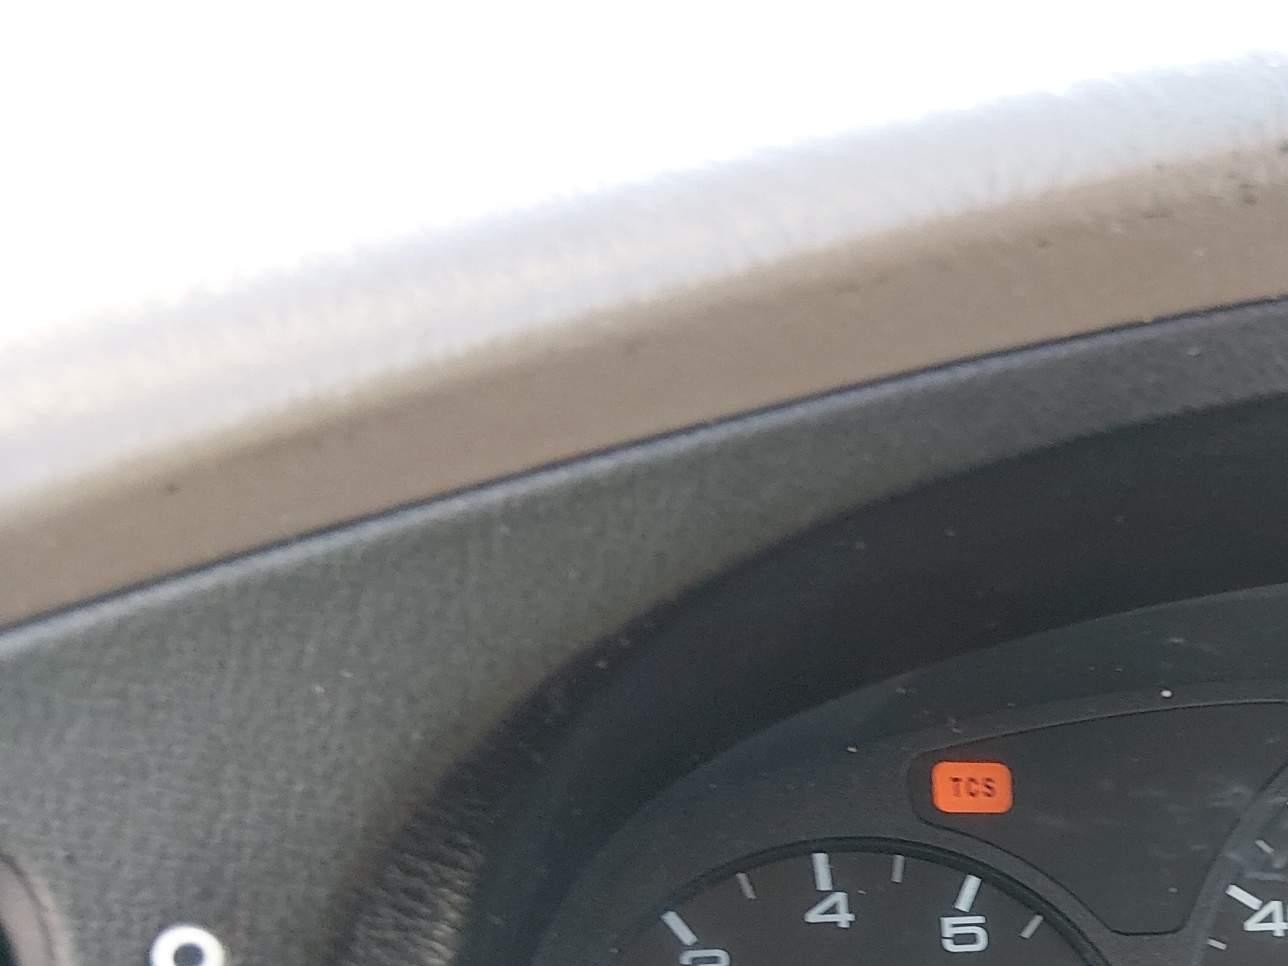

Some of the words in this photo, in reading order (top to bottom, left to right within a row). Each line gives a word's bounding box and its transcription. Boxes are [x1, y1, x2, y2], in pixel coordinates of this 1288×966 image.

[949, 776, 997, 798] TCS
[805, 892, 855, 927] 4
[941, 916, 988, 953] 5
